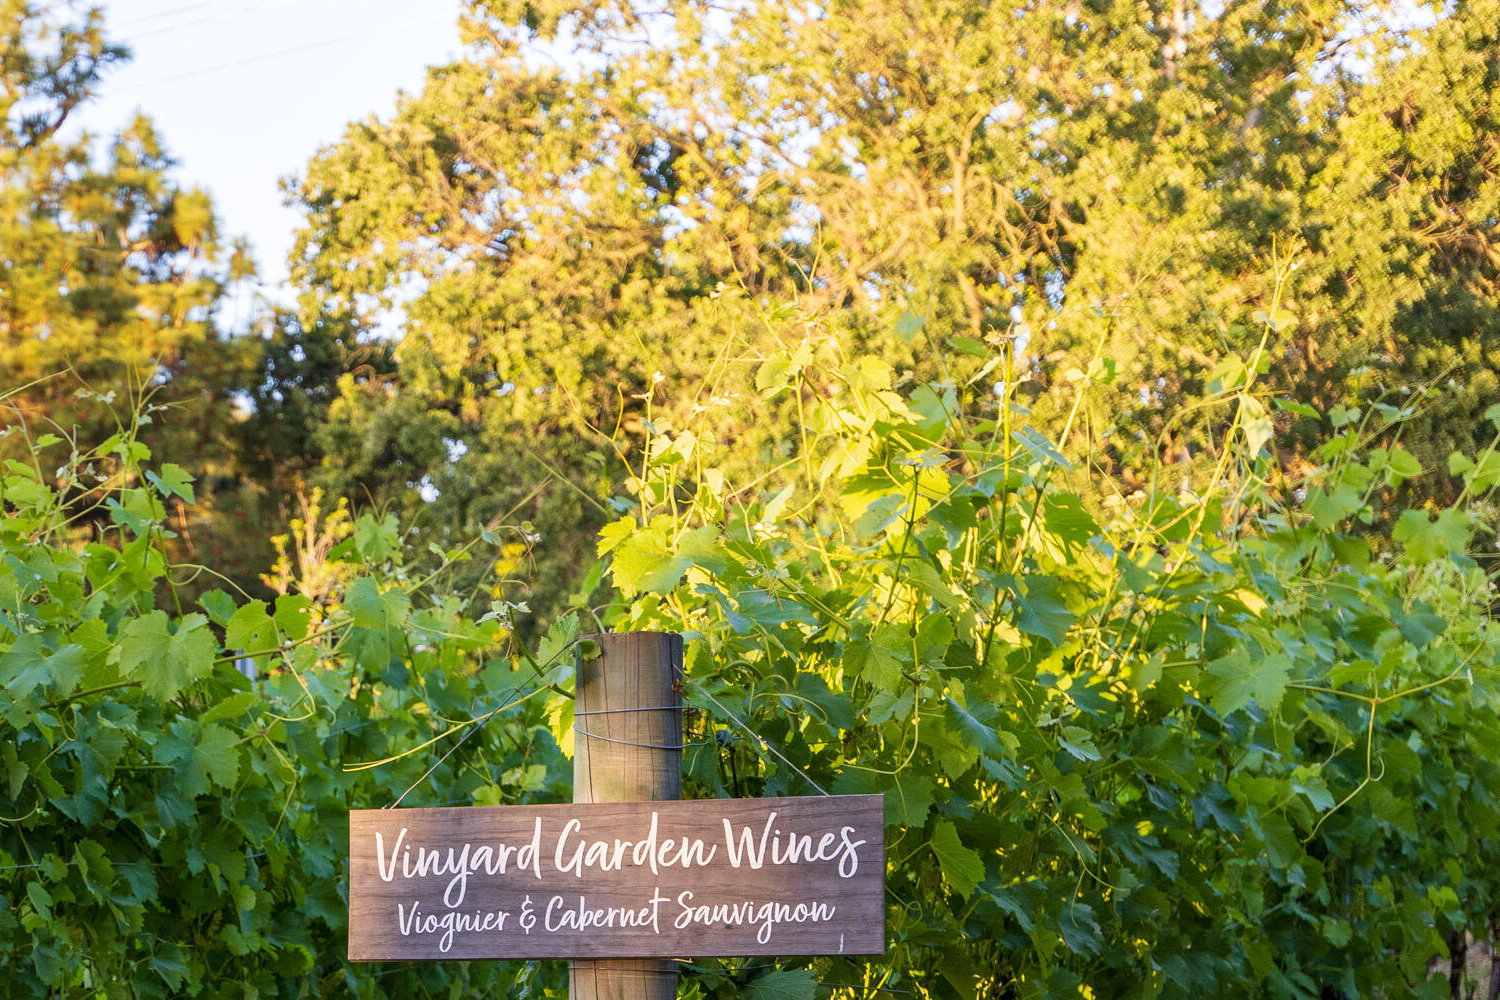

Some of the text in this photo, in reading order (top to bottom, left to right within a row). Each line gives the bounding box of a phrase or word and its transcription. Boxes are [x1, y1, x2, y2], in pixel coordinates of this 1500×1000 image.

[375, 812, 866, 909] Vinyard Garden Wines
[397, 887, 836, 953] Viognier & Cabernet Sauvignon
